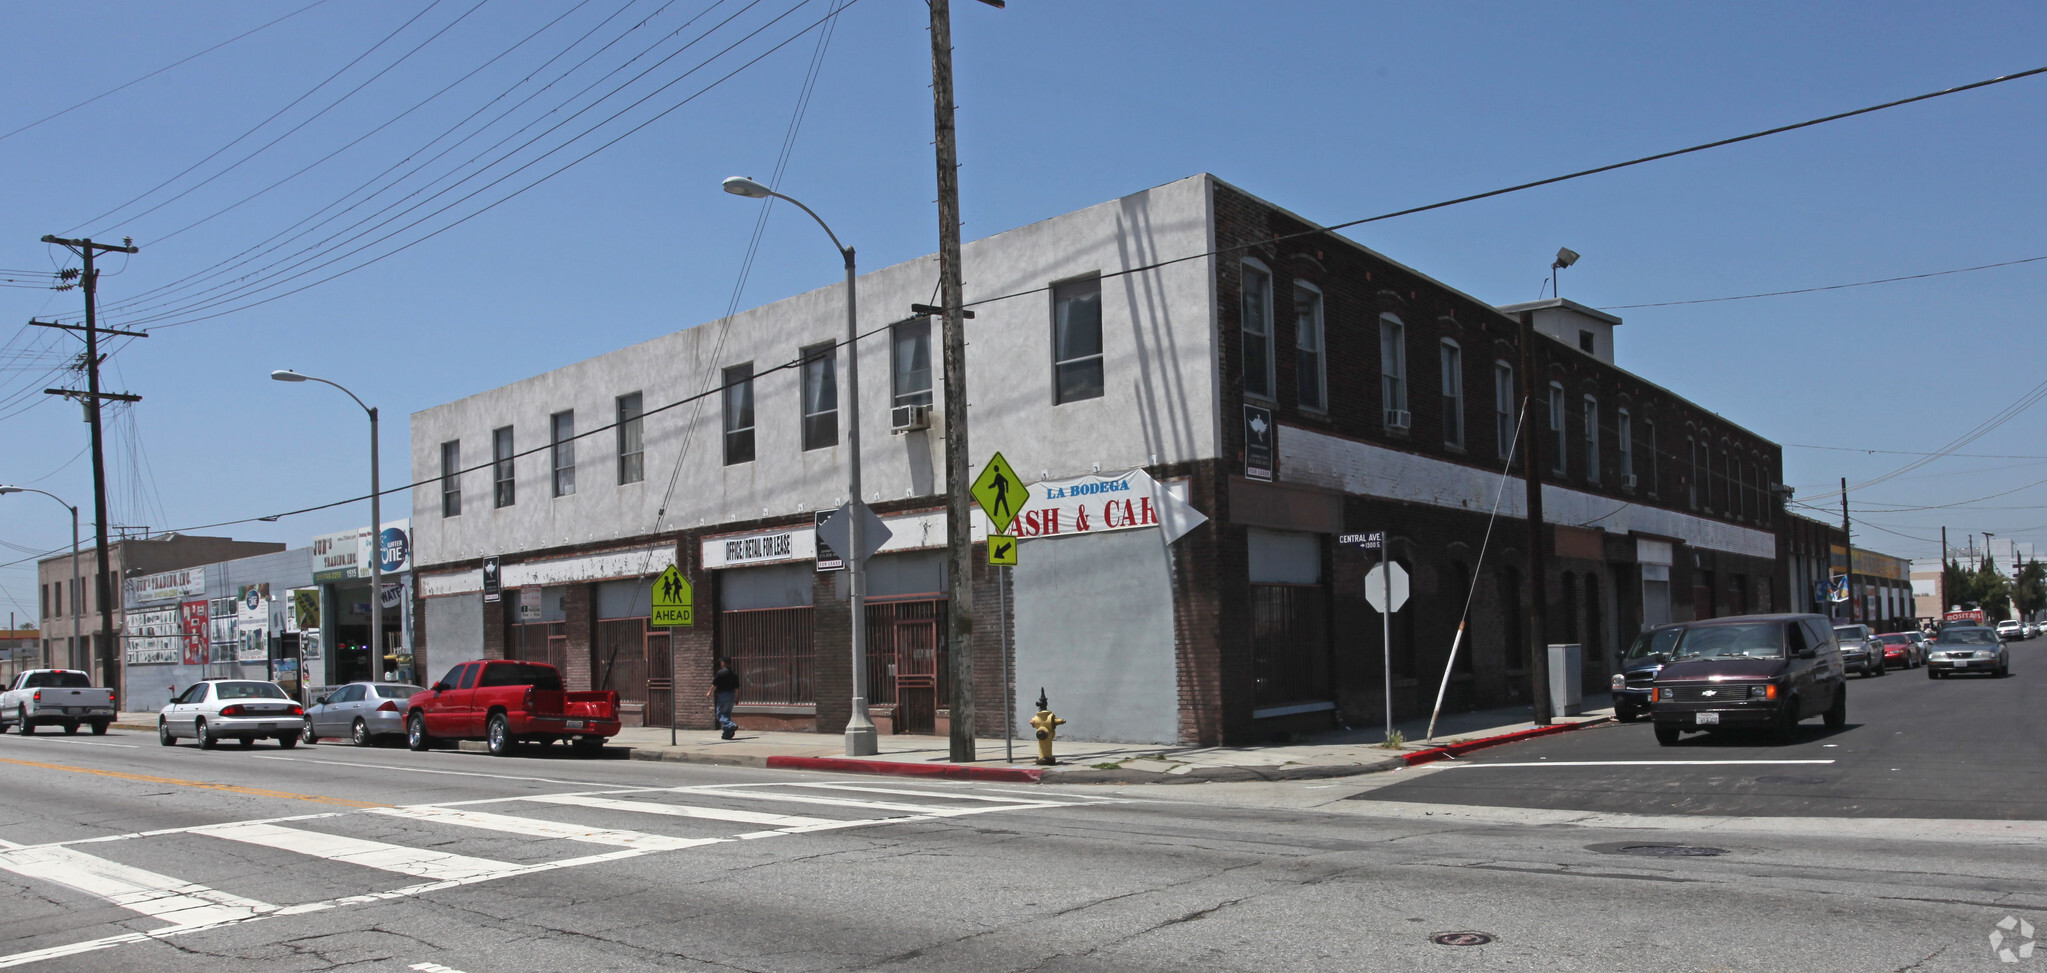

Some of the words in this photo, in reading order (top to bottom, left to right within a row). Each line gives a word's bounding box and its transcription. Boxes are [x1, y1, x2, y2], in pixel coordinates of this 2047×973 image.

[1047, 487, 1066, 499] LA
[1070, 480, 1130, 497] BODEGA
[996, 507, 1061, 538] ASH
[1076, 504, 1091, 532] &
[313, 538, 333, 556] JUN'S
[387, 540, 403, 548] WATER
[763, 536, 773, 557] FOR
[774, 534, 791, 555] LEASE
[1339, 534, 1366, 543] CENTRAL
[381, 547, 402, 565] ONE
[655, 610, 690, 620] AHEAD
